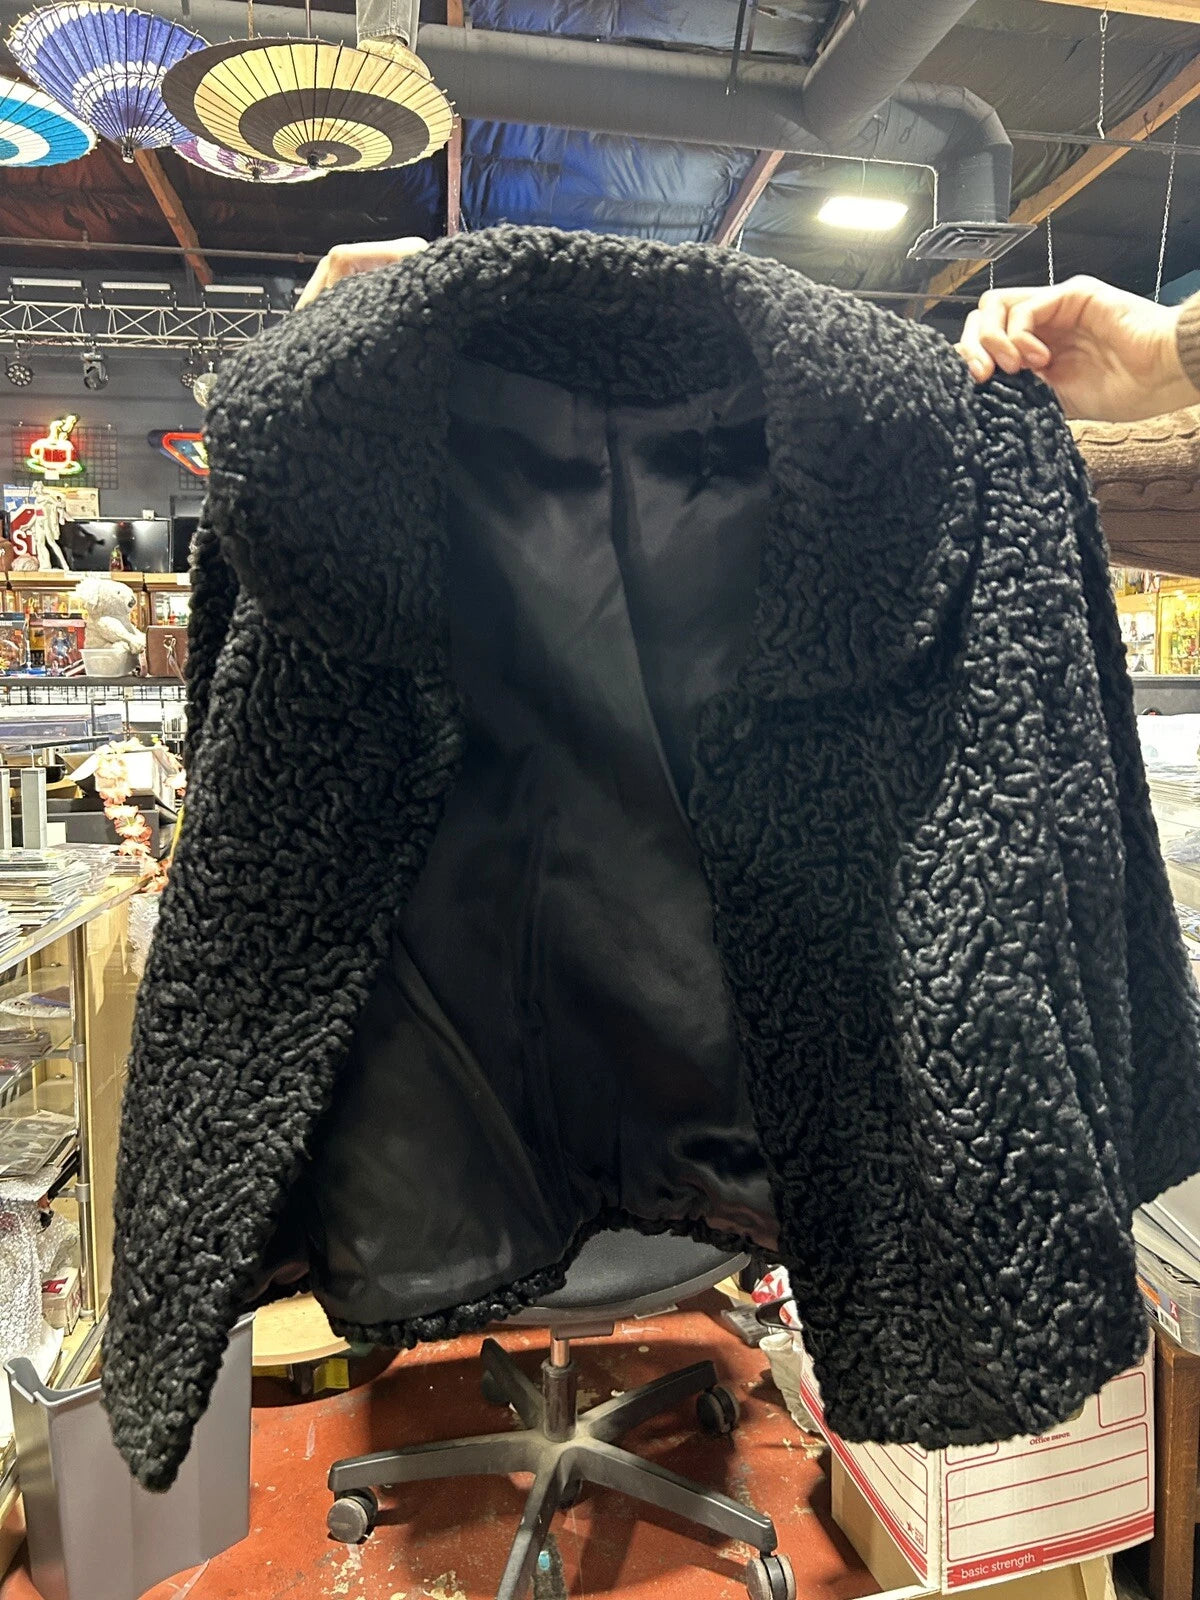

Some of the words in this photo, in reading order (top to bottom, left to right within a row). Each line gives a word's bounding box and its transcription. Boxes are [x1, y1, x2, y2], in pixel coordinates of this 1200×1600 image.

[13, 529, 37, 556] ST
[961, 1565, 989, 1579] basic
[991, 1552, 1036, 1568] strength
